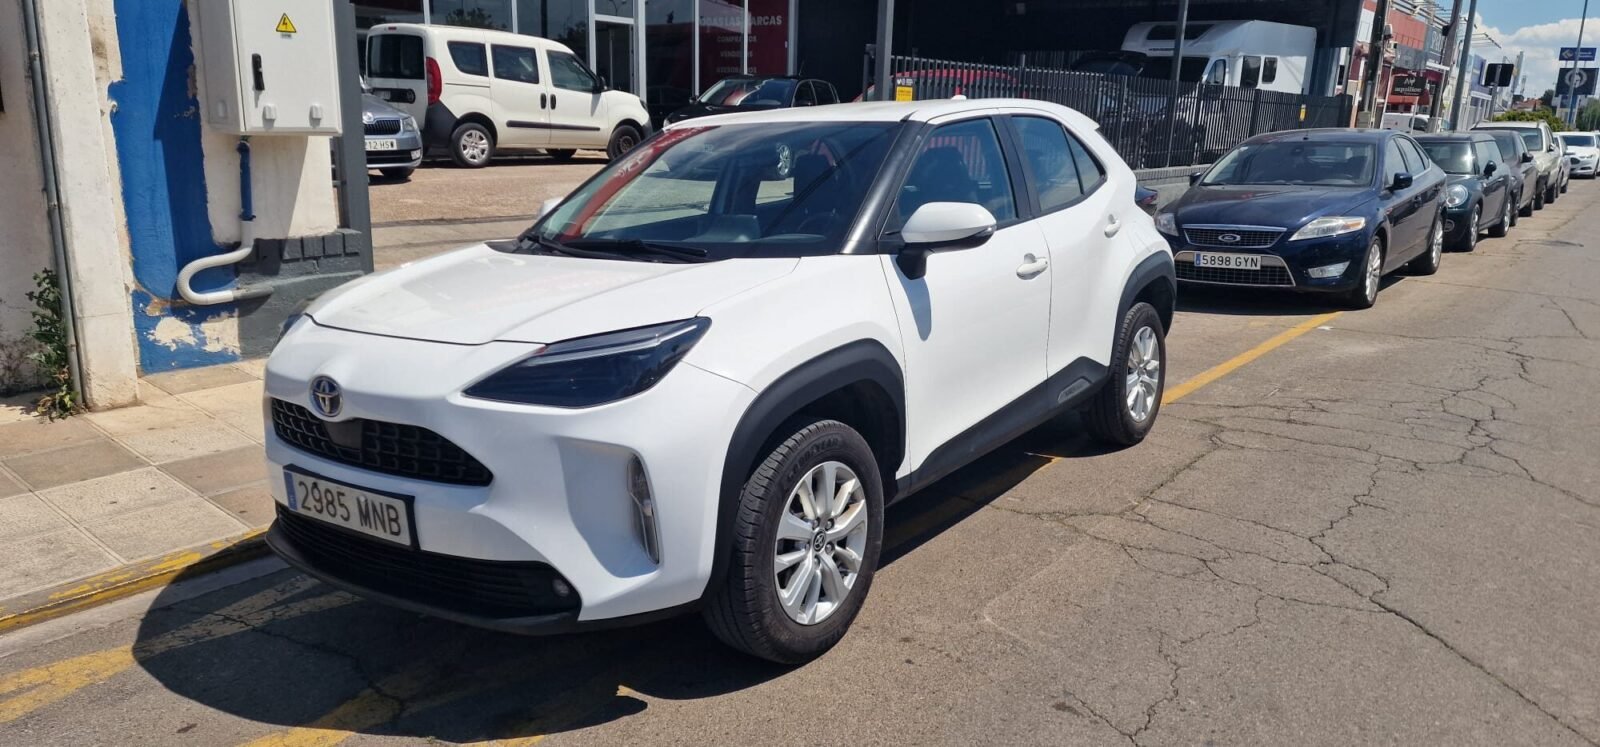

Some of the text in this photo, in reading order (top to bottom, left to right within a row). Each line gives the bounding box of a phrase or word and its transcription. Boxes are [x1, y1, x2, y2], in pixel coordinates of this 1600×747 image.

[747, 15, 783, 26] ARCAS
[366, 141, 378, 150] 12
[1202, 255, 1258, 268] 5898 GYN
[298, 481, 401, 536] 2985 MNB
